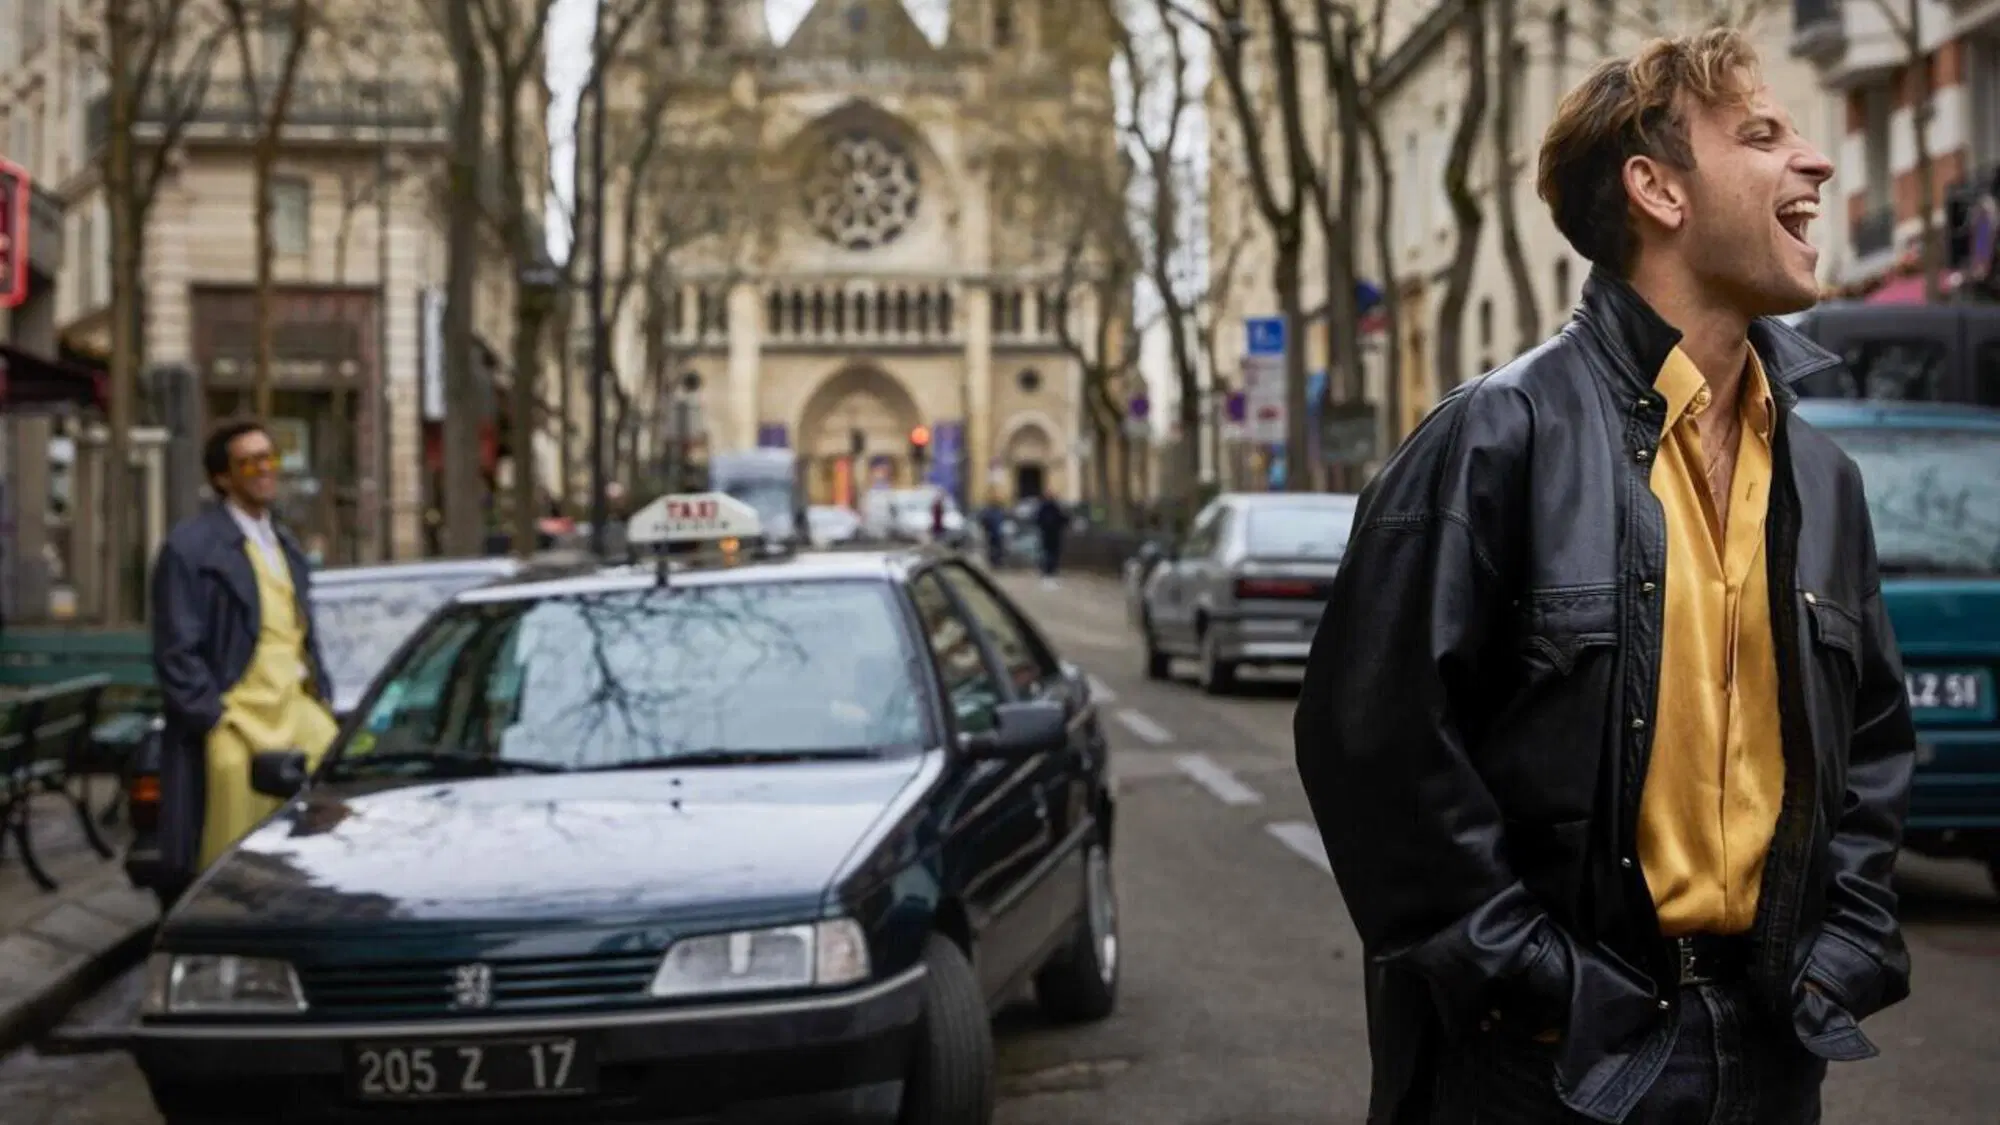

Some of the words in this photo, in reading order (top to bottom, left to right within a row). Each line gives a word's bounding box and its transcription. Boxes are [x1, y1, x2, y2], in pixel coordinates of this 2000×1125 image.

[666, 499, 719, 518] TAXI
[358, 1047, 437, 1094] 205
[458, 1046, 487, 1091] Z
[528, 1038, 577, 1089] 17
